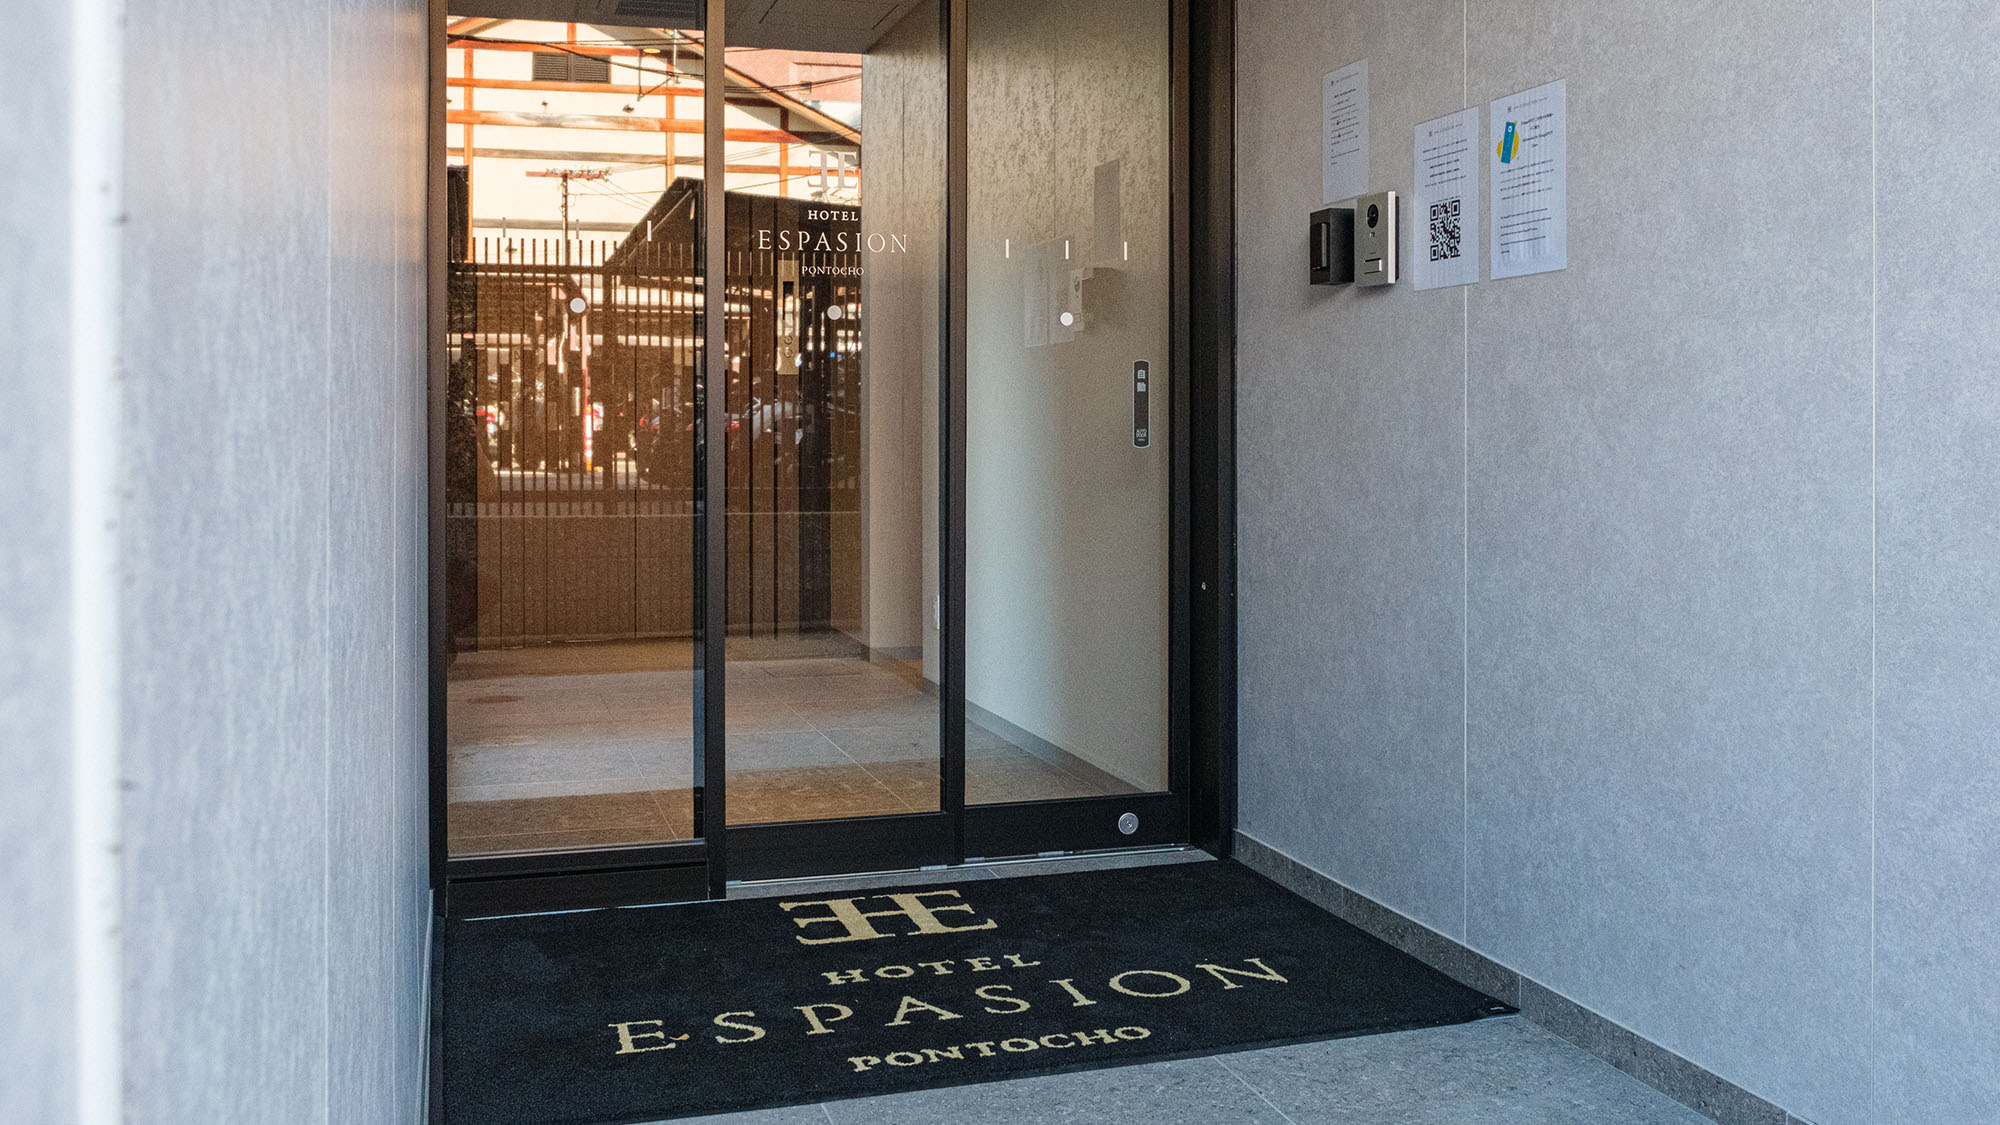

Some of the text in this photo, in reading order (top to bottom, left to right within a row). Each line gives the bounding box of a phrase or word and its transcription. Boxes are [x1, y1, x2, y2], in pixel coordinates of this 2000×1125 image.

[807, 210, 859, 222] HOTEL
[758, 229, 908, 254] ESPASION
[801, 265, 865, 277] PONTOCHO
[822, 954, 1043, 987] HOTEL
[608, 957, 1289, 1056] ESPASION
[848, 1024, 1153, 1073] PONTOCHO
